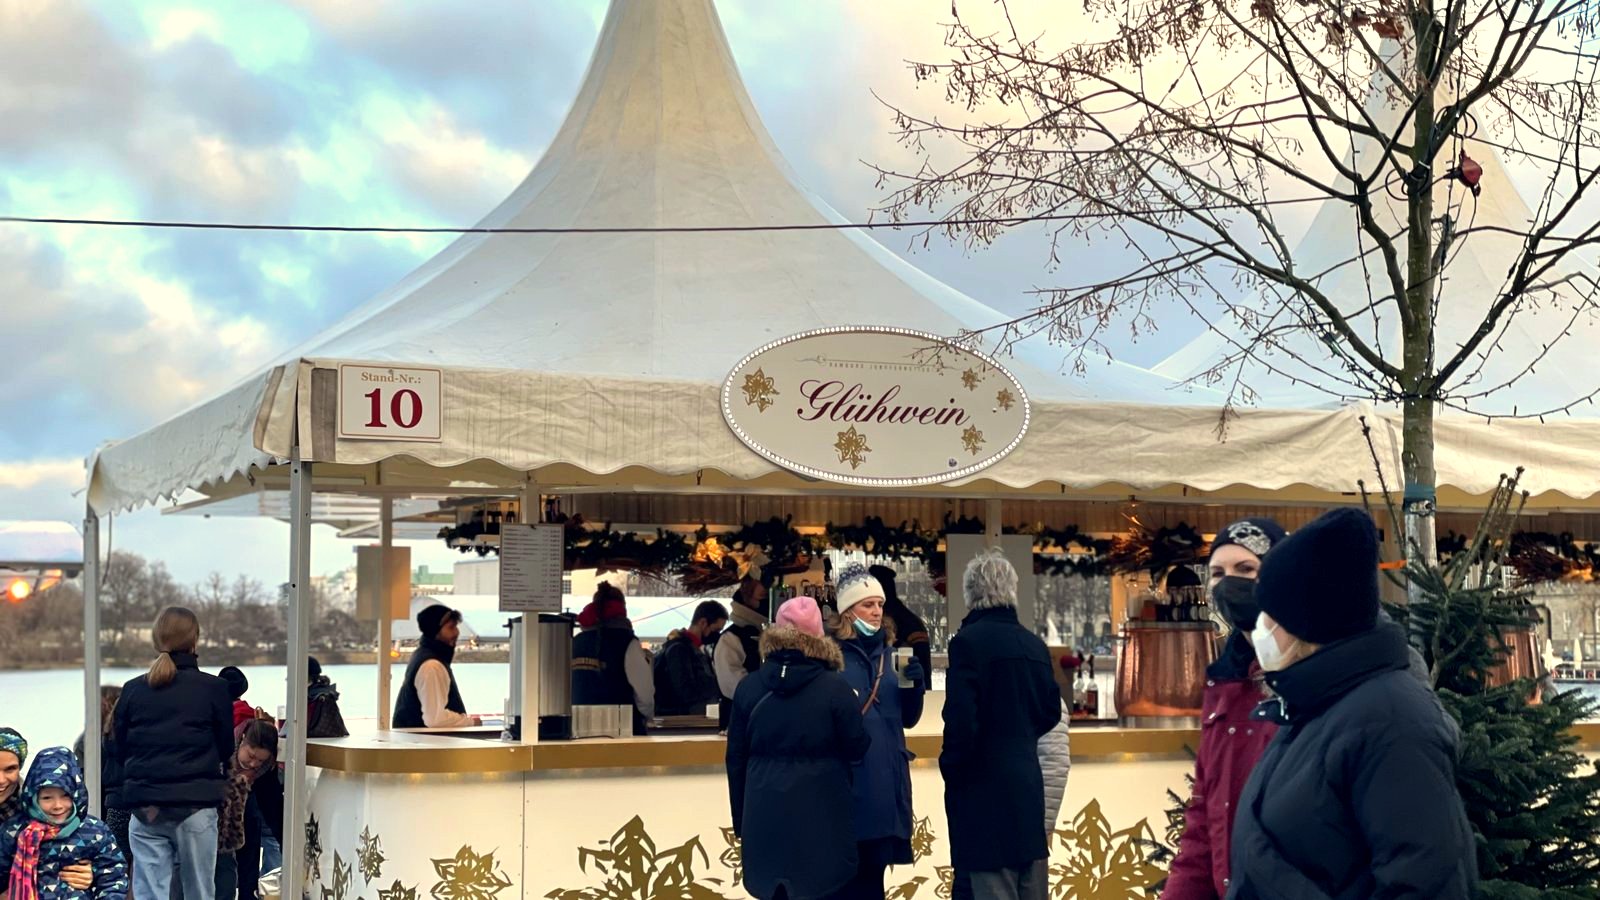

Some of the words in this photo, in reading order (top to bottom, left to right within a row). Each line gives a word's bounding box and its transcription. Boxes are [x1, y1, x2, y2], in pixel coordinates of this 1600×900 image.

[361, 371, 421, 384] Stand-Nr.:
[364, 387, 423, 429] 10
[797, 379, 971, 426] Glühwein
